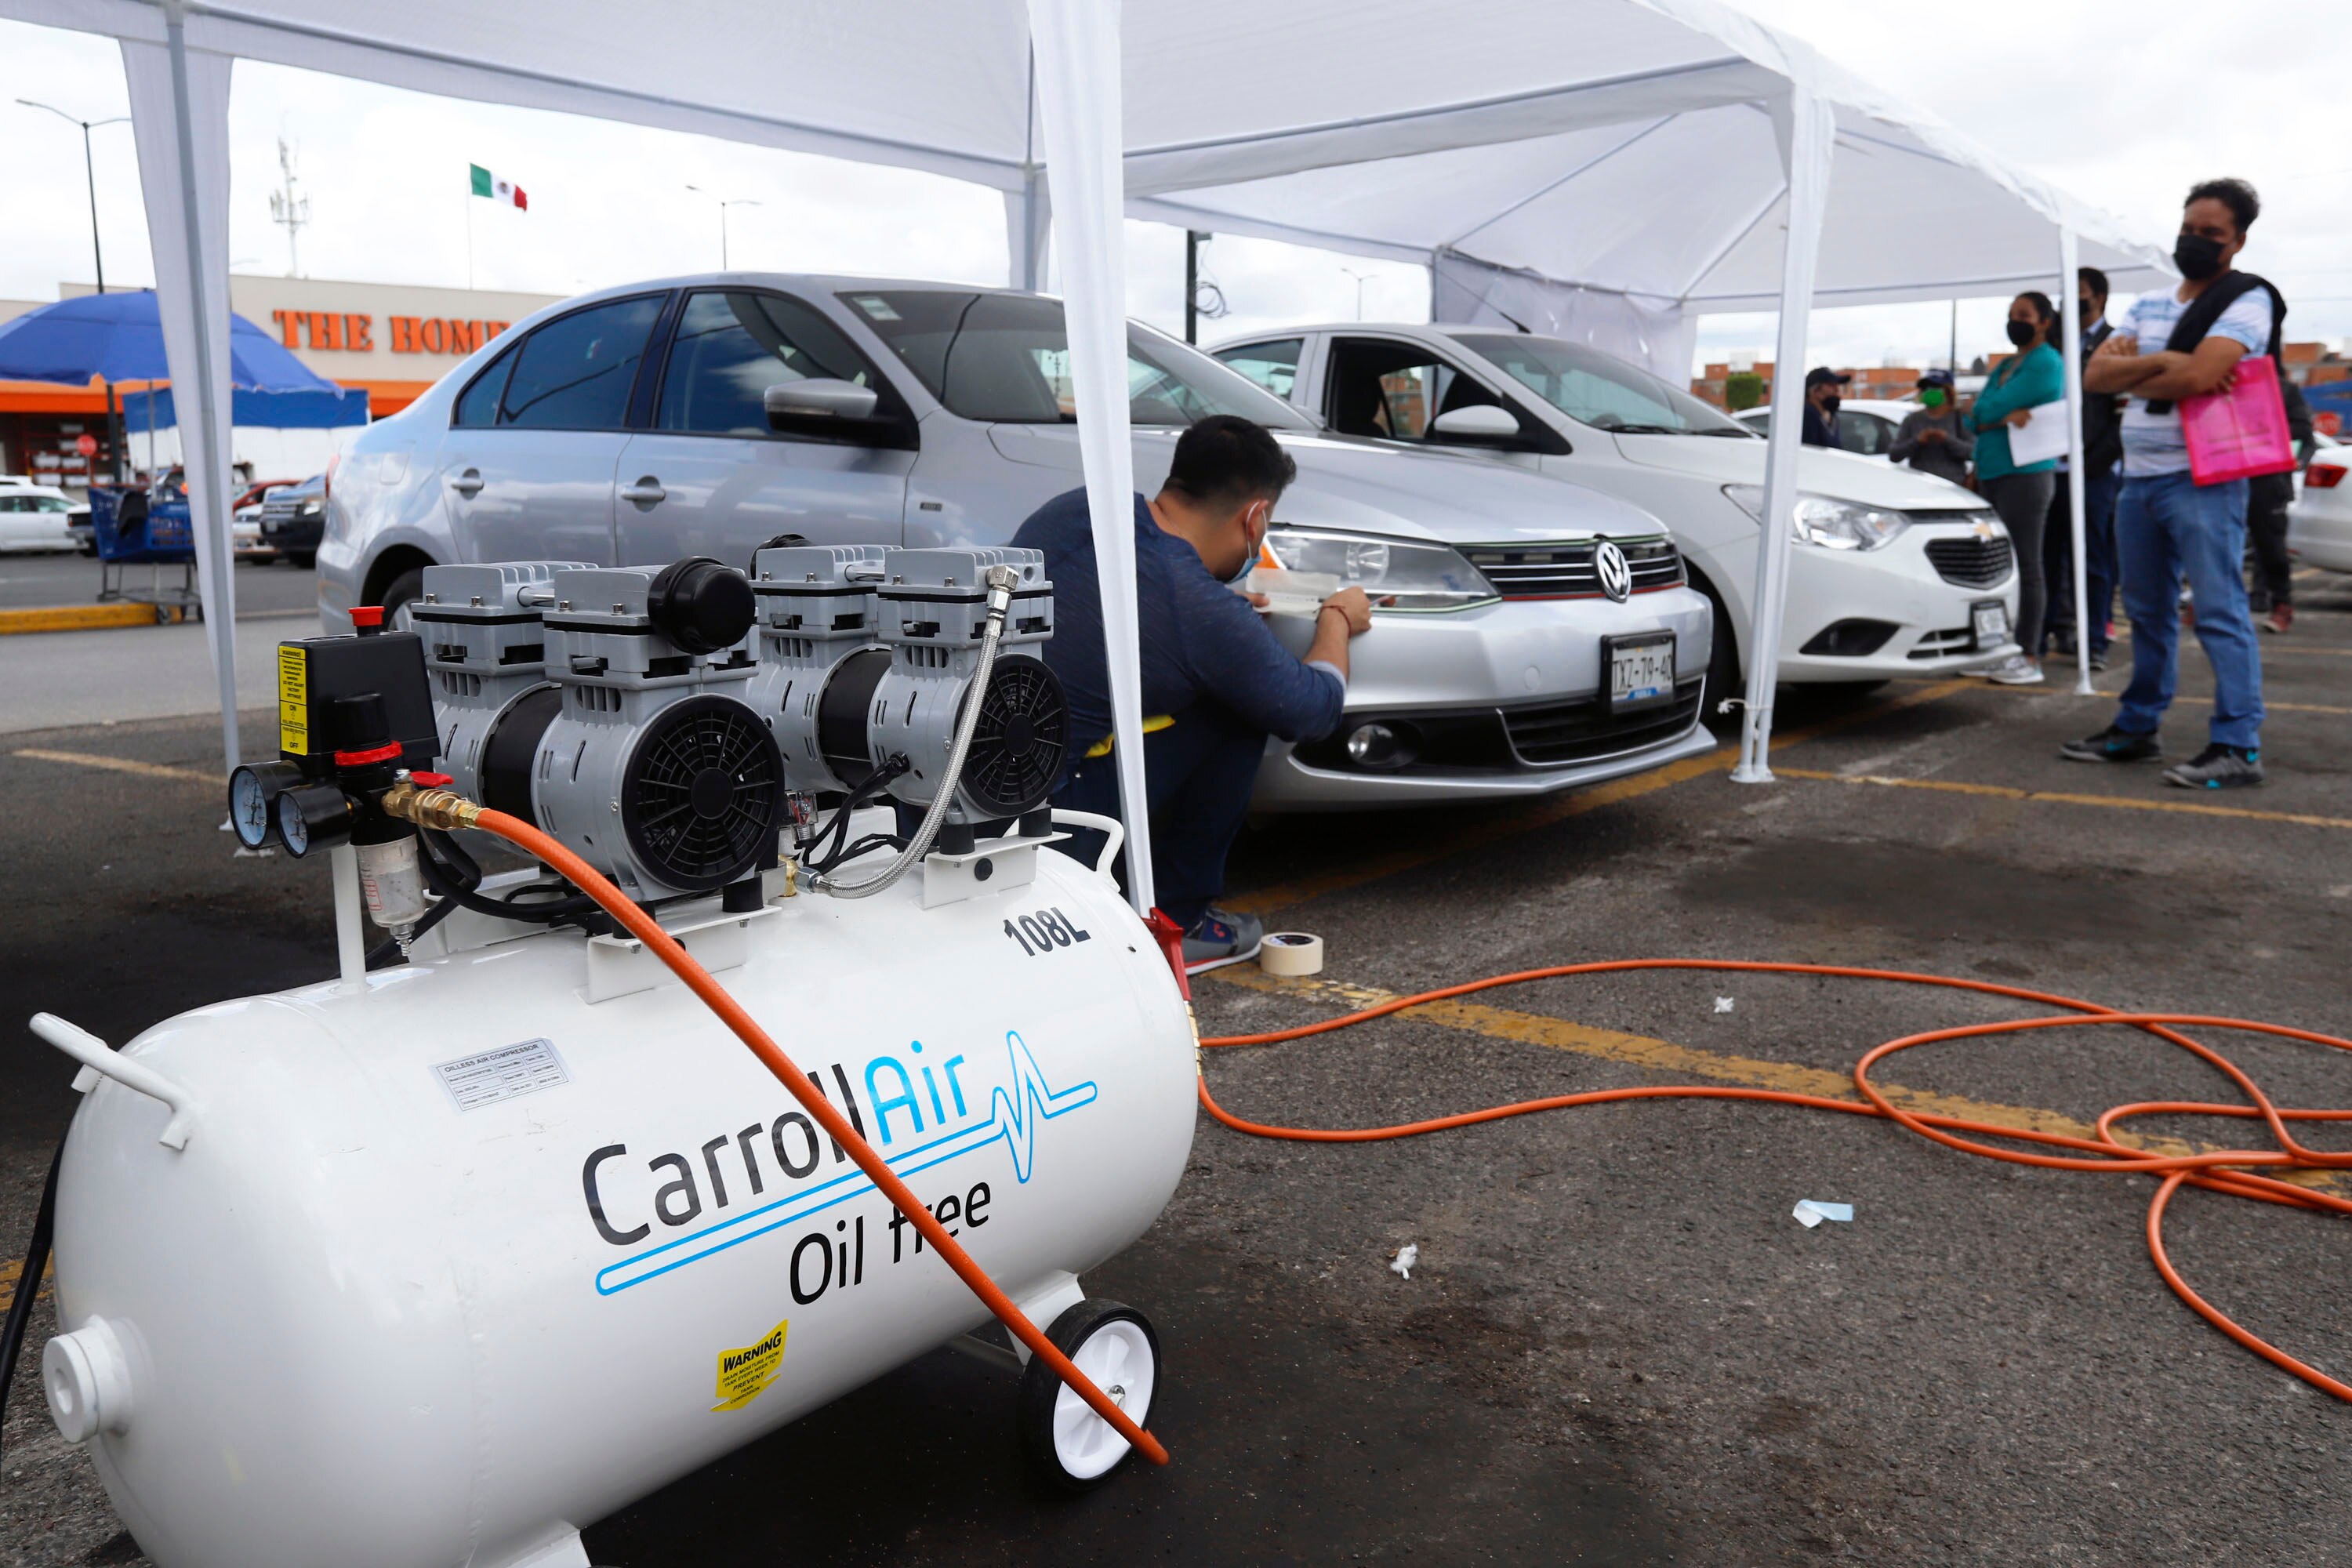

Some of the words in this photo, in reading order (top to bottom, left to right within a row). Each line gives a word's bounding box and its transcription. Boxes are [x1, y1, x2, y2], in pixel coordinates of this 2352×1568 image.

[273, 310, 374, 352] THE
[1004, 907, 1091, 956] 108L
[445, 1060, 476, 1073] OILLESS
[489, 1044, 539, 1061] COMPRESSOR
[789, 1215, 864, 1305] Oil
[722, 1371, 739, 1383] DRAIN
[739, 1358, 764, 1374] MOISTURE
[765, 1350, 780, 1361] FROM
[724, 1330, 782, 1374] WARNING
[724, 1377, 737, 1388] TANK
[738, 1369, 753, 1381] EVERY
[754, 1363, 768, 1373] WEEK
[732, 1370, 765, 1392] PREVENT
